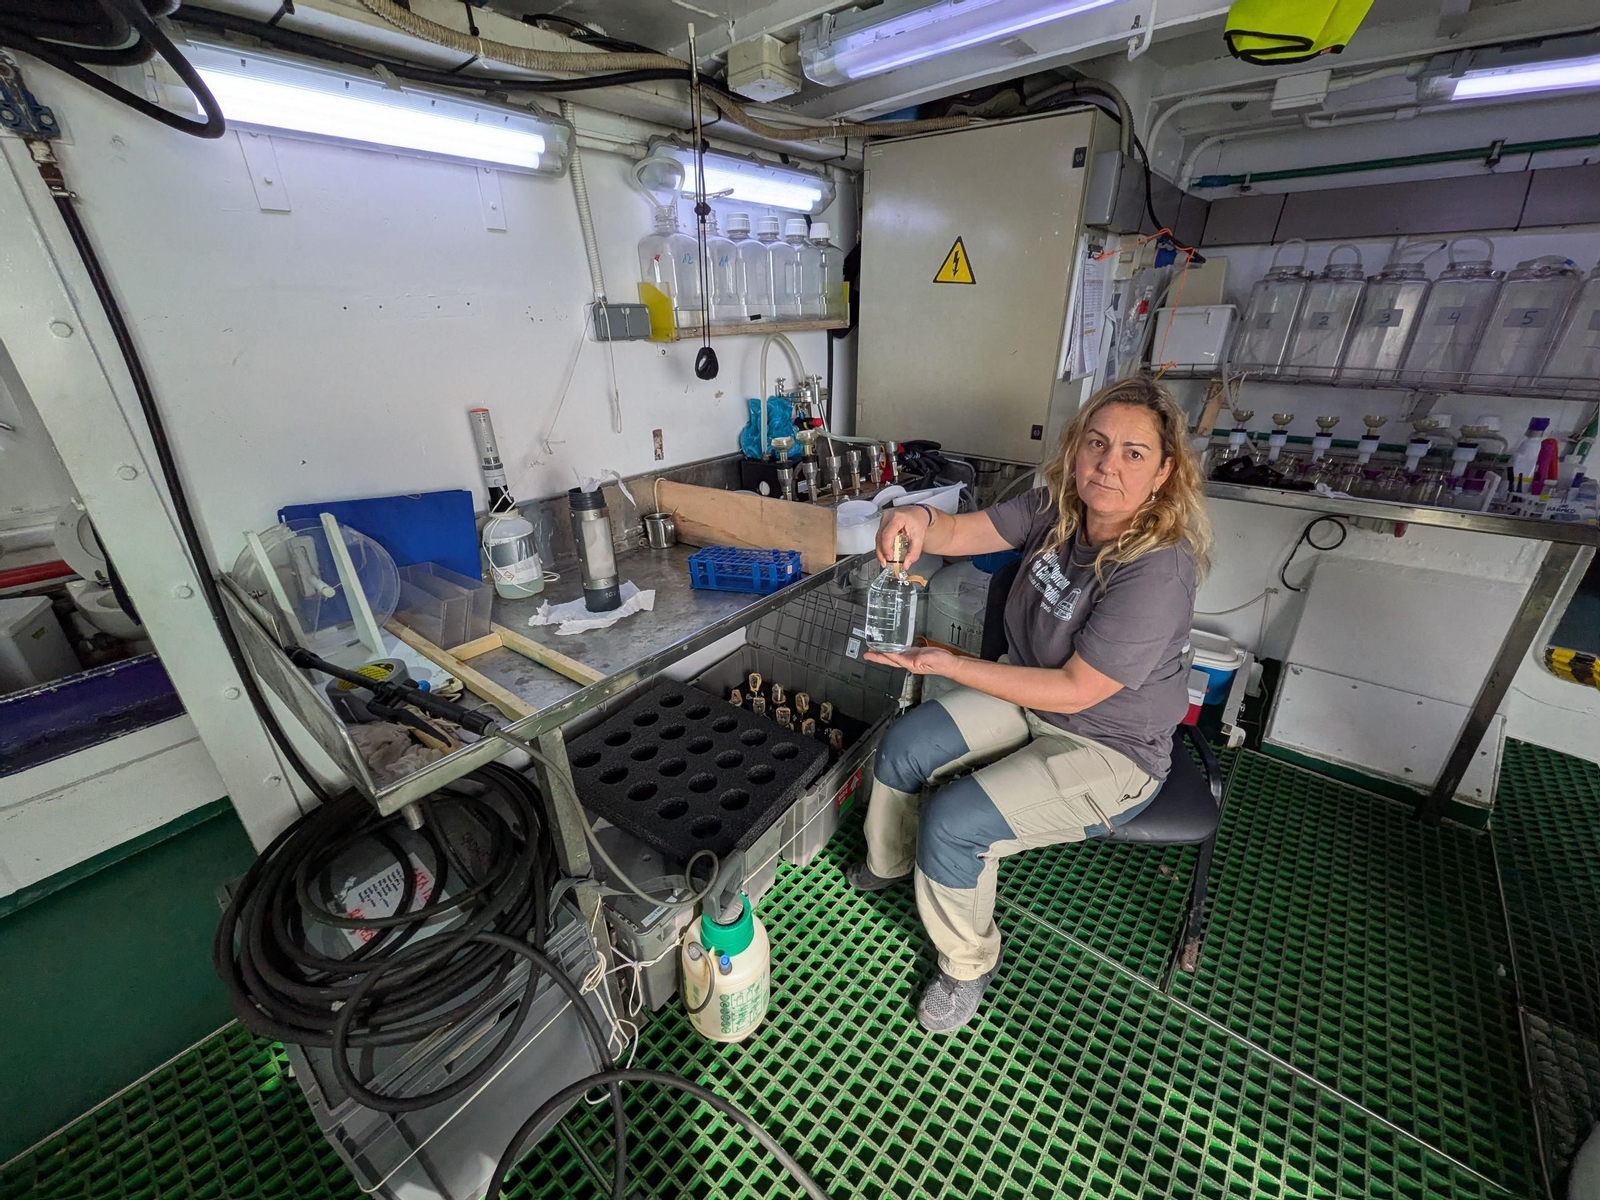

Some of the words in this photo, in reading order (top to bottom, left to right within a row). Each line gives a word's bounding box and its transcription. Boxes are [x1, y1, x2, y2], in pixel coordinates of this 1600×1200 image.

[1318, 315, 1330, 326] 2
[1379, 312, 1391, 324] 3
[1447, 311, 1462, 324] 4
[1521, 310, 1538, 325] 5
